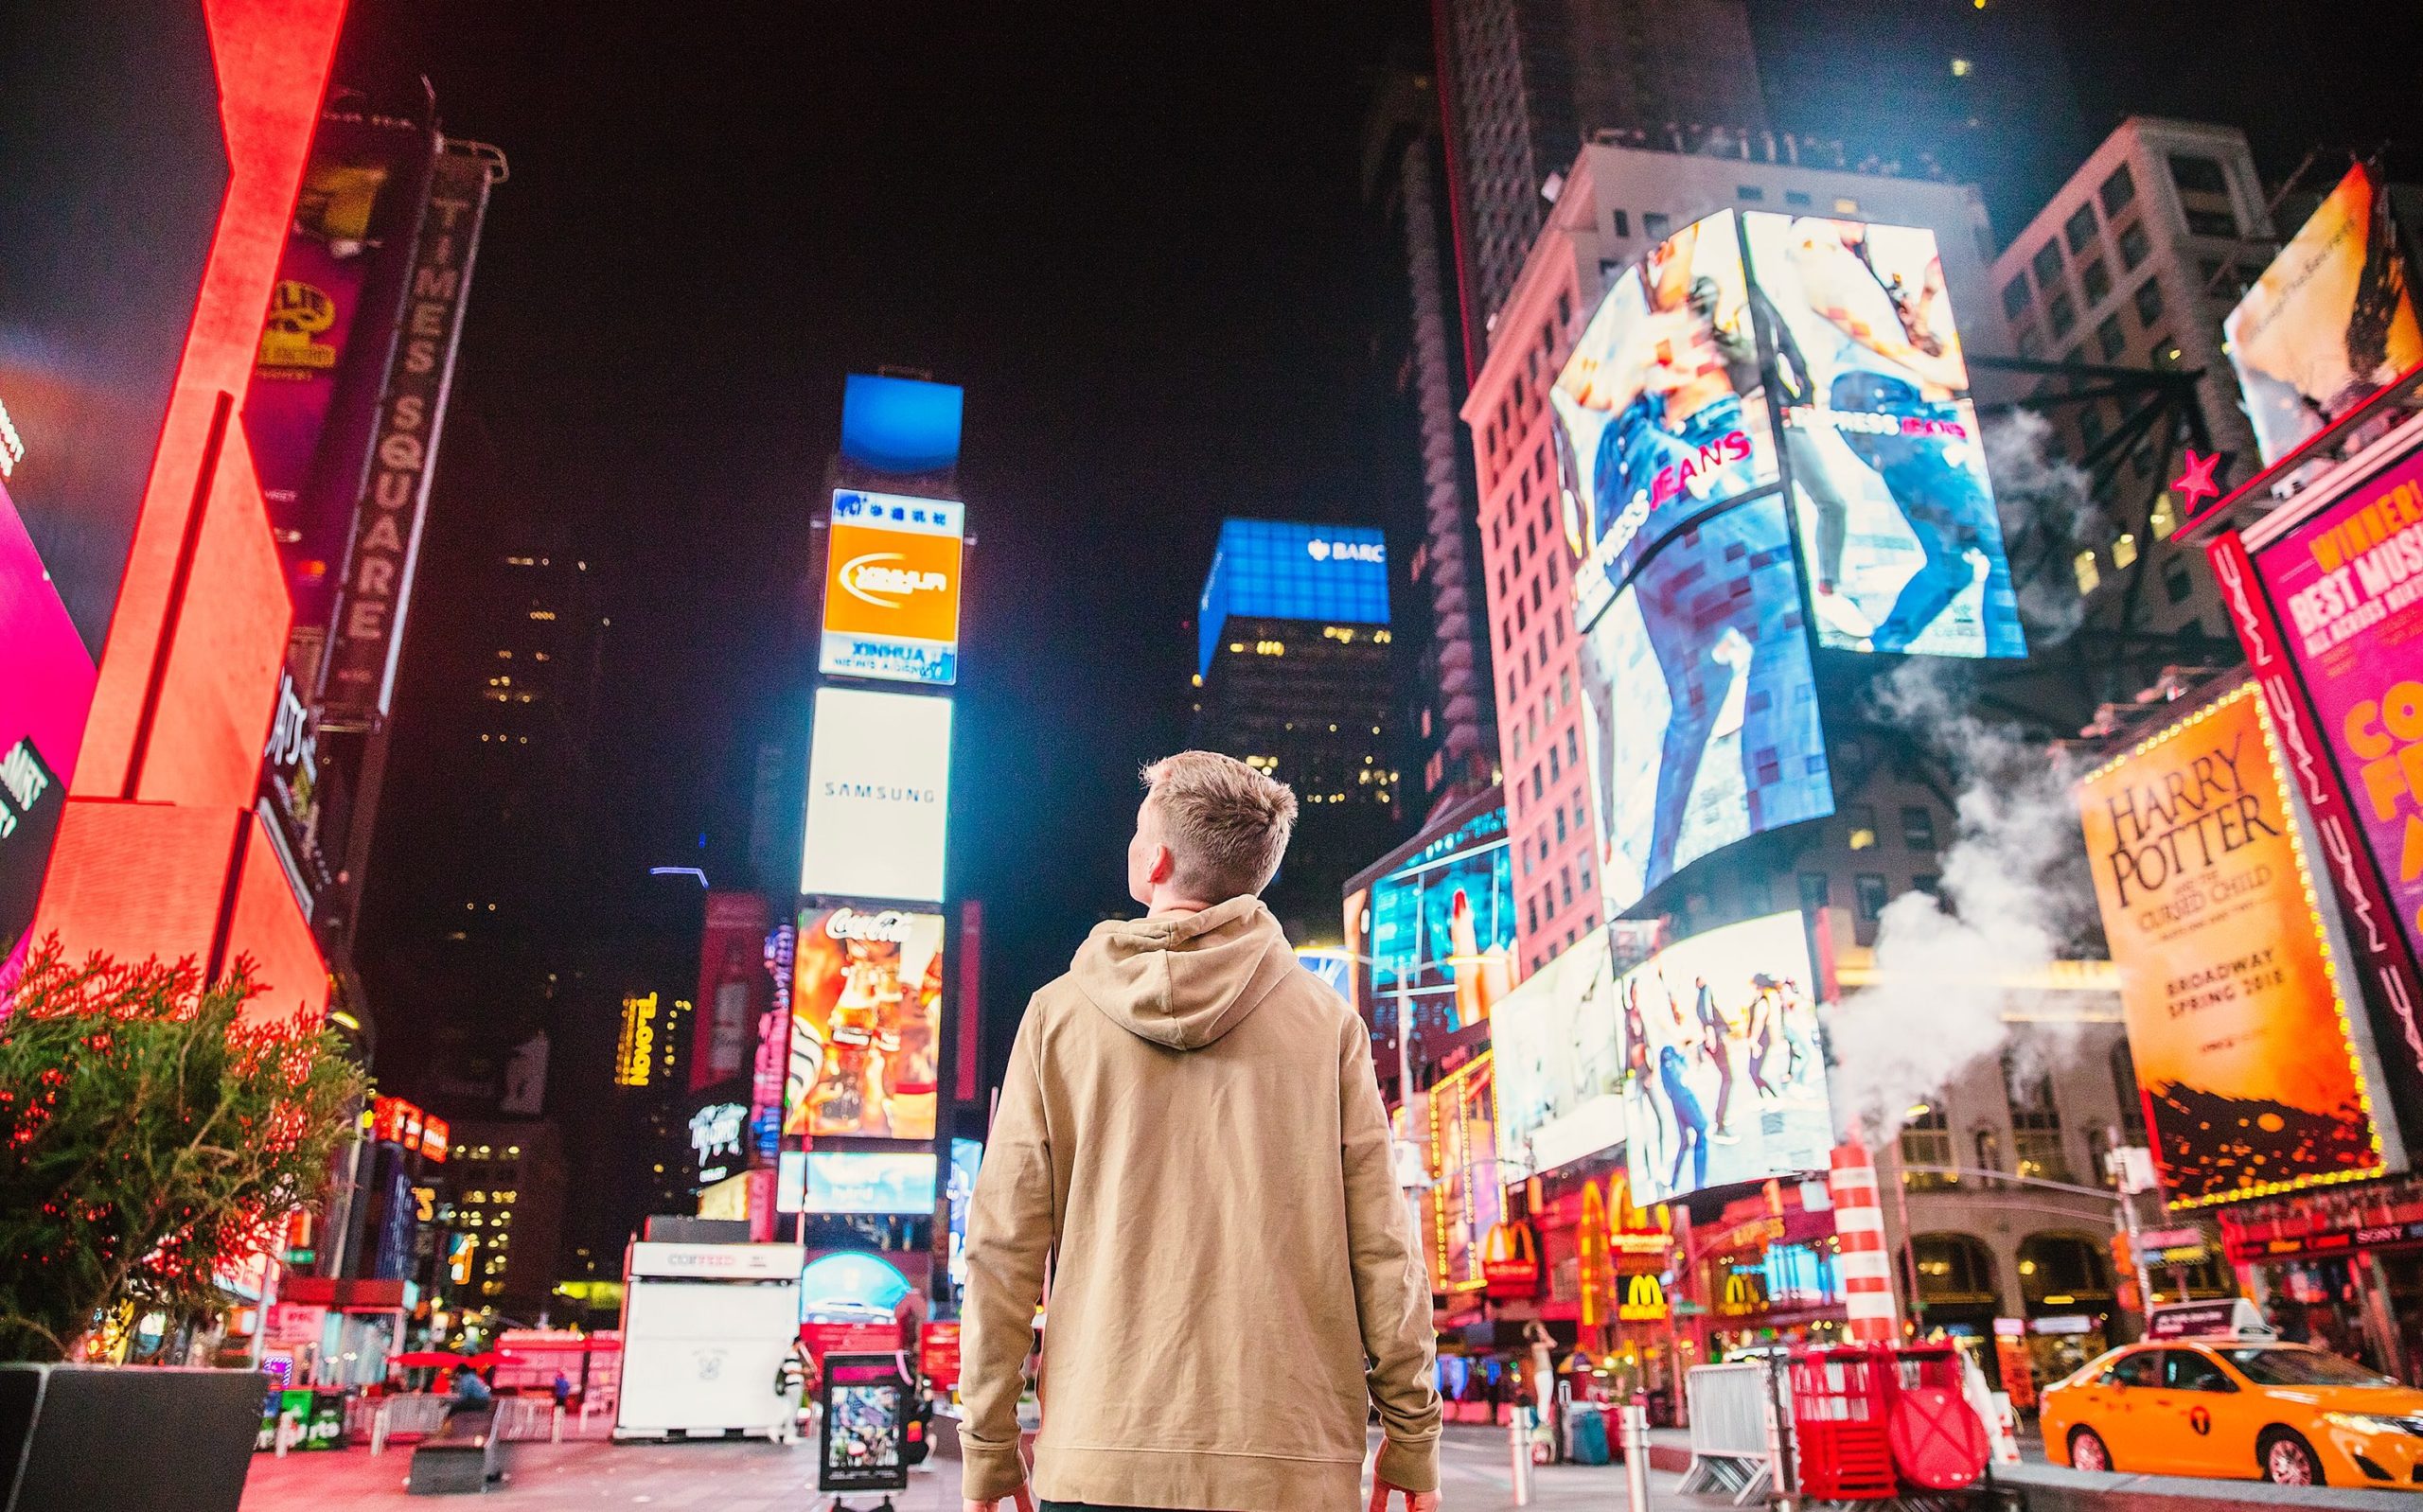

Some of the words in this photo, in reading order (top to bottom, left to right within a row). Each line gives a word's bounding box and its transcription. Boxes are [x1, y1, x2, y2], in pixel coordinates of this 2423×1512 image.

[404, 197, 470, 374] TIMES
[1651, 430, 1751, 511] JEANS
[347, 396, 423, 641] SQUARE
[2287, 564, 2360, 638] BEST
[824, 782, 934, 803] SAMSUNG
[2106, 731, 2245, 847] HARRY
[2110, 794, 2279, 908] POTTER
[2167, 948, 2273, 996] BROADWAY
[2167, 985, 2236, 1019] SPRING
[628, 992, 658, 1085] NOVOTEL
